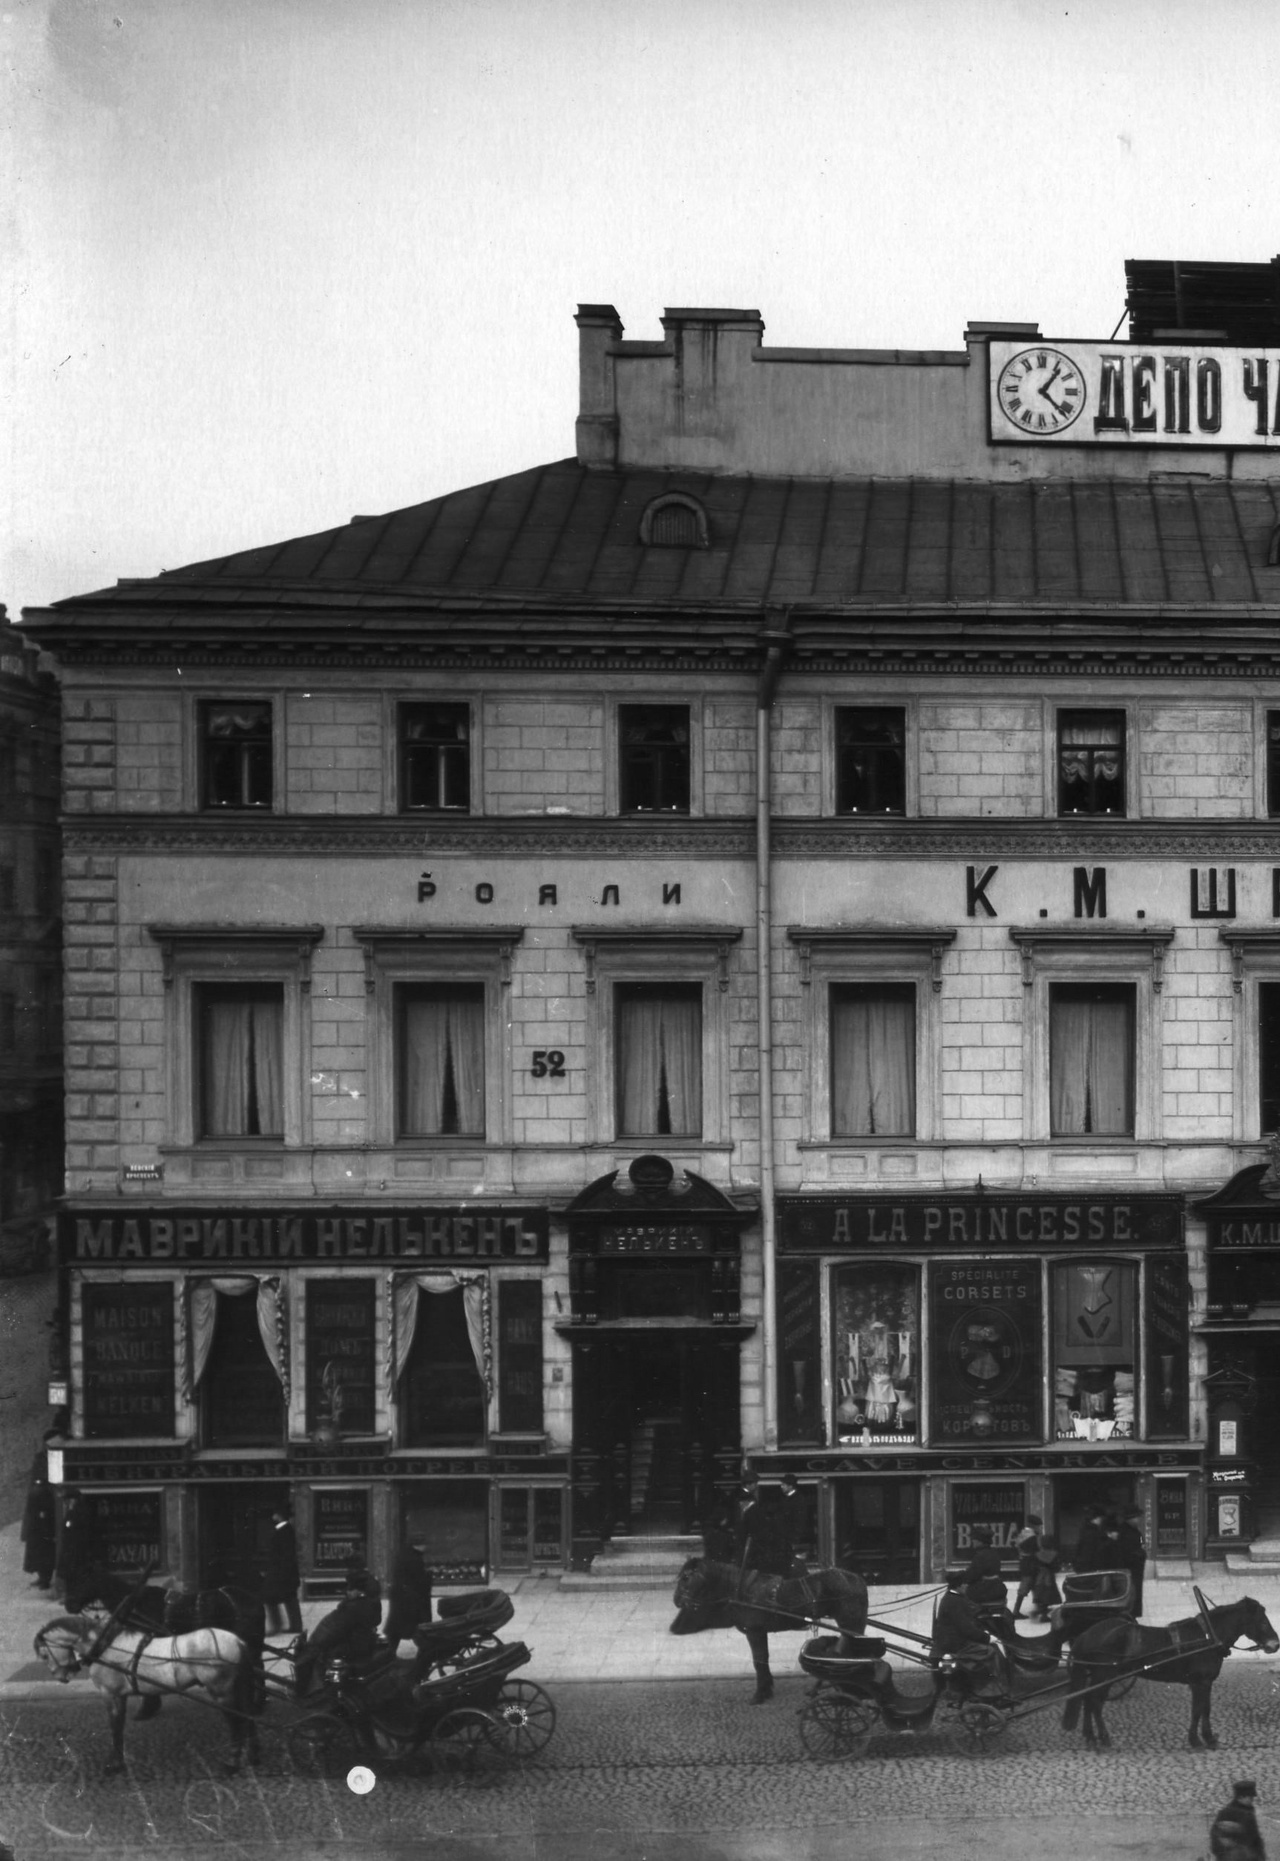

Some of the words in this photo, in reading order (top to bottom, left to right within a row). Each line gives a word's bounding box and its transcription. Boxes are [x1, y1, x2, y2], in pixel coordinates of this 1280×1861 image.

[1094, 354, 1222, 435] ДЕПО
[417, 882, 681, 905] РОЯЛИ
[531, 1050, 566, 1078] 52
[833, 1208, 852, 1242] A
[868, 1208, 907, 1242] LA
[76, 1217, 302, 1258] МАВРИКІЙ
[316, 1217, 538, 1257] НЕЛЬКЕНЪ
[944, 1286, 1027, 1300] CORSETS
[94, 1308, 162, 1328] MAISON
[943, 1419, 1031, 1433] КОРТОВЪ
[358, 1457, 521, 1474] ПОГРЕБЪ
[806, 1456, 918, 1471] CAVE
[941, 1453, 1180, 1470] CENTRALE
